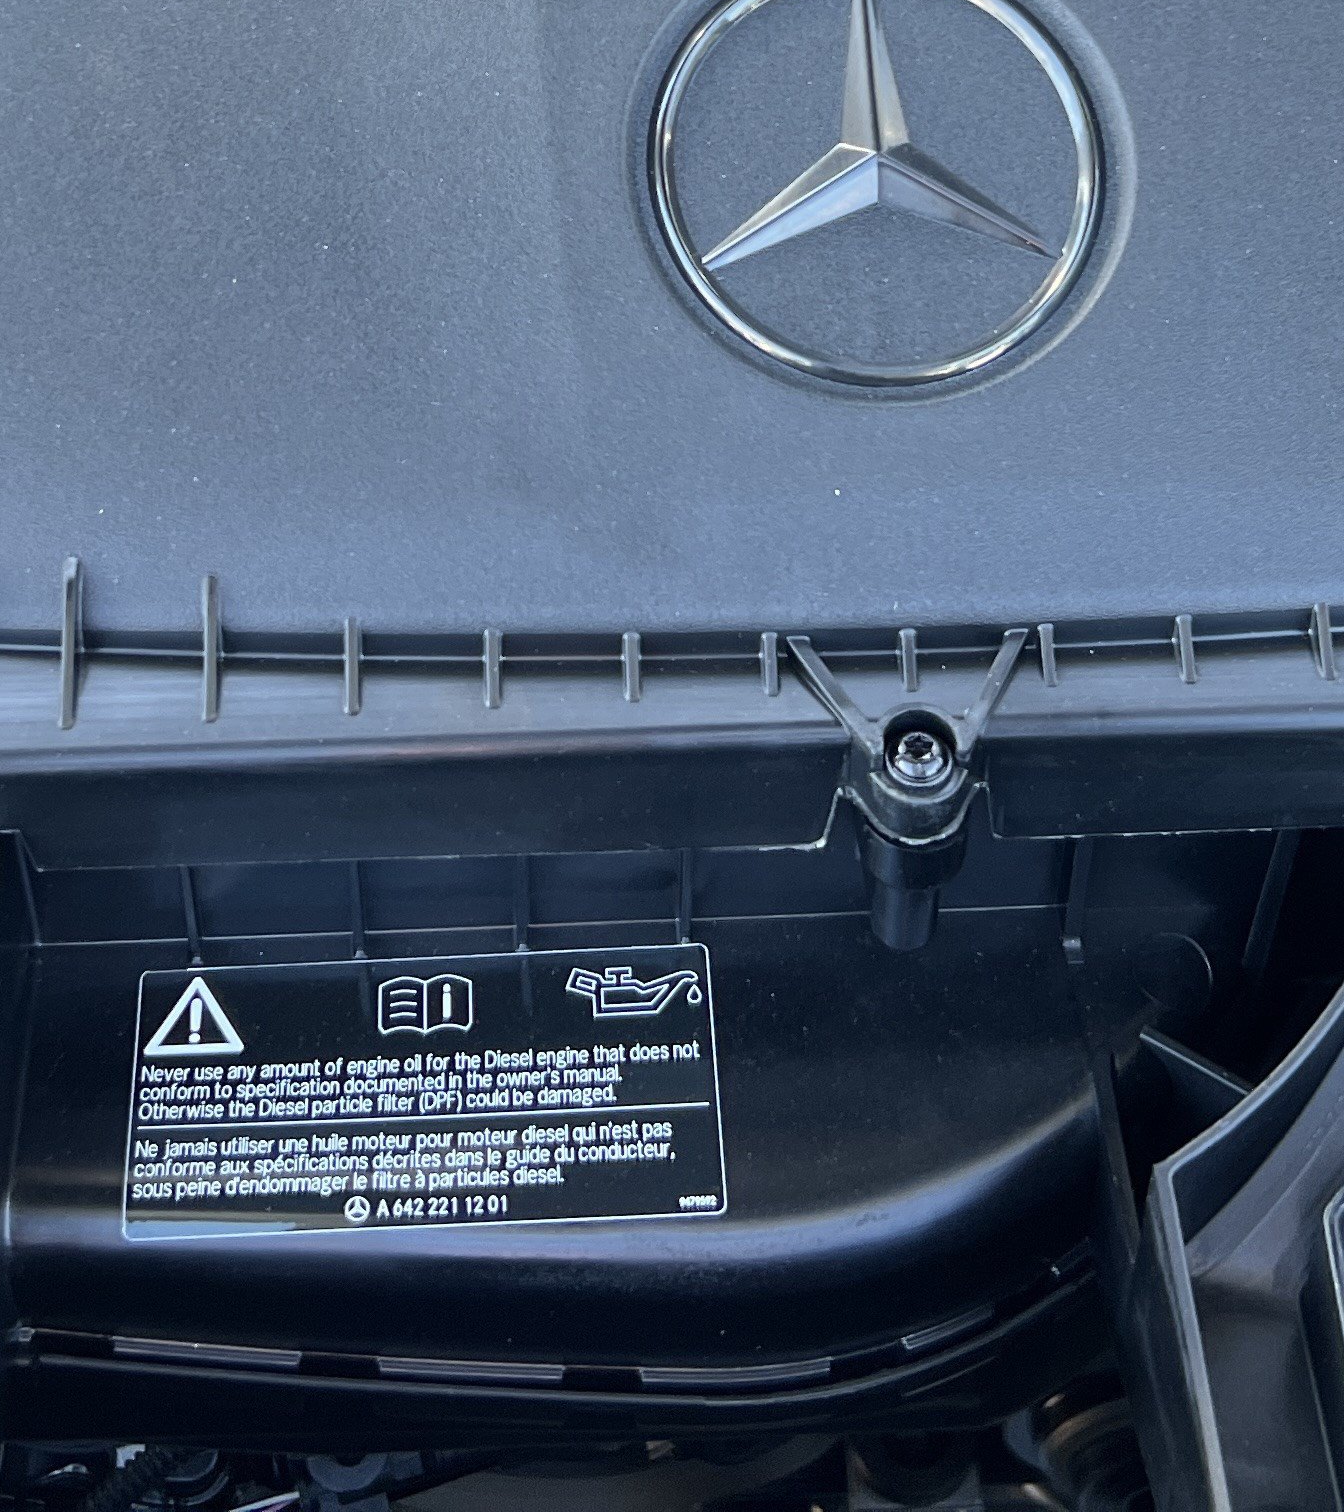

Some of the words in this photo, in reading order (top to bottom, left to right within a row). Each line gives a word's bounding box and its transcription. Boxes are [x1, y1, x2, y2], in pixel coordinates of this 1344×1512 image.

[141, 1065, 190, 1082] Never
[194, 1066, 223, 1080] use
[227, 1065, 256, 1084] any
[260, 1059, 320, 1078] amount
[325, 1058, 343, 1075] of
[347, 1055, 400, 1079] engine
[404, 1054, 422, 1072] oil
[426, 1053, 449, 1072] for
[455, 1052, 481, 1069] the
[484, 1048, 533, 1070] Diesel
[536, 1046, 589, 1068] engine
[593, 1043, 626, 1063] that
[629, 1042, 669, 1061] does
[673, 1041, 700, 1059] not
[139, 1082, 210, 1100] conform
[214, 1082, 232, 1097] to
[236, 1078, 340, 1102] specification
[344, 1072, 444, 1094] documented
[448, 1072, 462, 1088] in
[467, 1070, 493, 1088] the
[496, 1066, 560, 1086] owner's
[563, 1064, 623, 1084] manual.
[138, 1101, 224, 1120] Otherwise
[228, 1100, 255, 1117] the
[259, 1097, 308, 1117] Diesel
[311, 1096, 372, 1118] particle
[378, 1094, 415, 1114] filter
[419, 1091, 462, 1113] (DPF)
[466, 1089, 507, 1108] could
[512, 1088, 534, 1105] be
[537, 1084, 617, 1105] damaged.
[134, 1140, 158, 1158] Ne
[162, 1138, 217, 1160] jamais
[220, 1137, 273, 1156] utiliser
[278, 1139, 308, 1153] une
[311, 1134, 348, 1152] huile
[351, 1132, 411, 1150] moteur
[416, 1131, 452, 1151] pour
[457, 1128, 517, 1147] moteur
[521, 1124, 569, 1144] diesel
[572, 1122, 596, 1143] qui
[600, 1120, 639, 1139] n'est
[642, 1121, 672, 1141] pas
[134, 1159, 216, 1178] conforme
[219, 1160, 249, 1174] aux
[254, 1153, 368, 1176] spécifications
[372, 1149, 441, 1170] décrites
[445, 1148, 484, 1167] dans
[487, 1147, 501, 1165] le
[506, 1144, 550, 1169] guide
[554, 1143, 575, 1162] du
[578, 1141, 676, 1163] conducteur,
[132, 1181, 172, 1199] sous
[176, 1178, 222, 1201] peine
[225, 1175, 349, 1197] d'endommager
[353, 1172, 367, 1190] le
[371, 1171, 411, 1189] filtre
[415, 1170, 426, 1188] à
[429, 1167, 509, 1190] particules
[512, 1165, 565, 1185] diesel.
[376, 1199, 389, 1218] A
[393, 1197, 424, 1217] 642
[428, 1197, 457, 1216] 221
[465, 1195, 484, 1214] 12
[487, 1195, 507, 1213] 01
